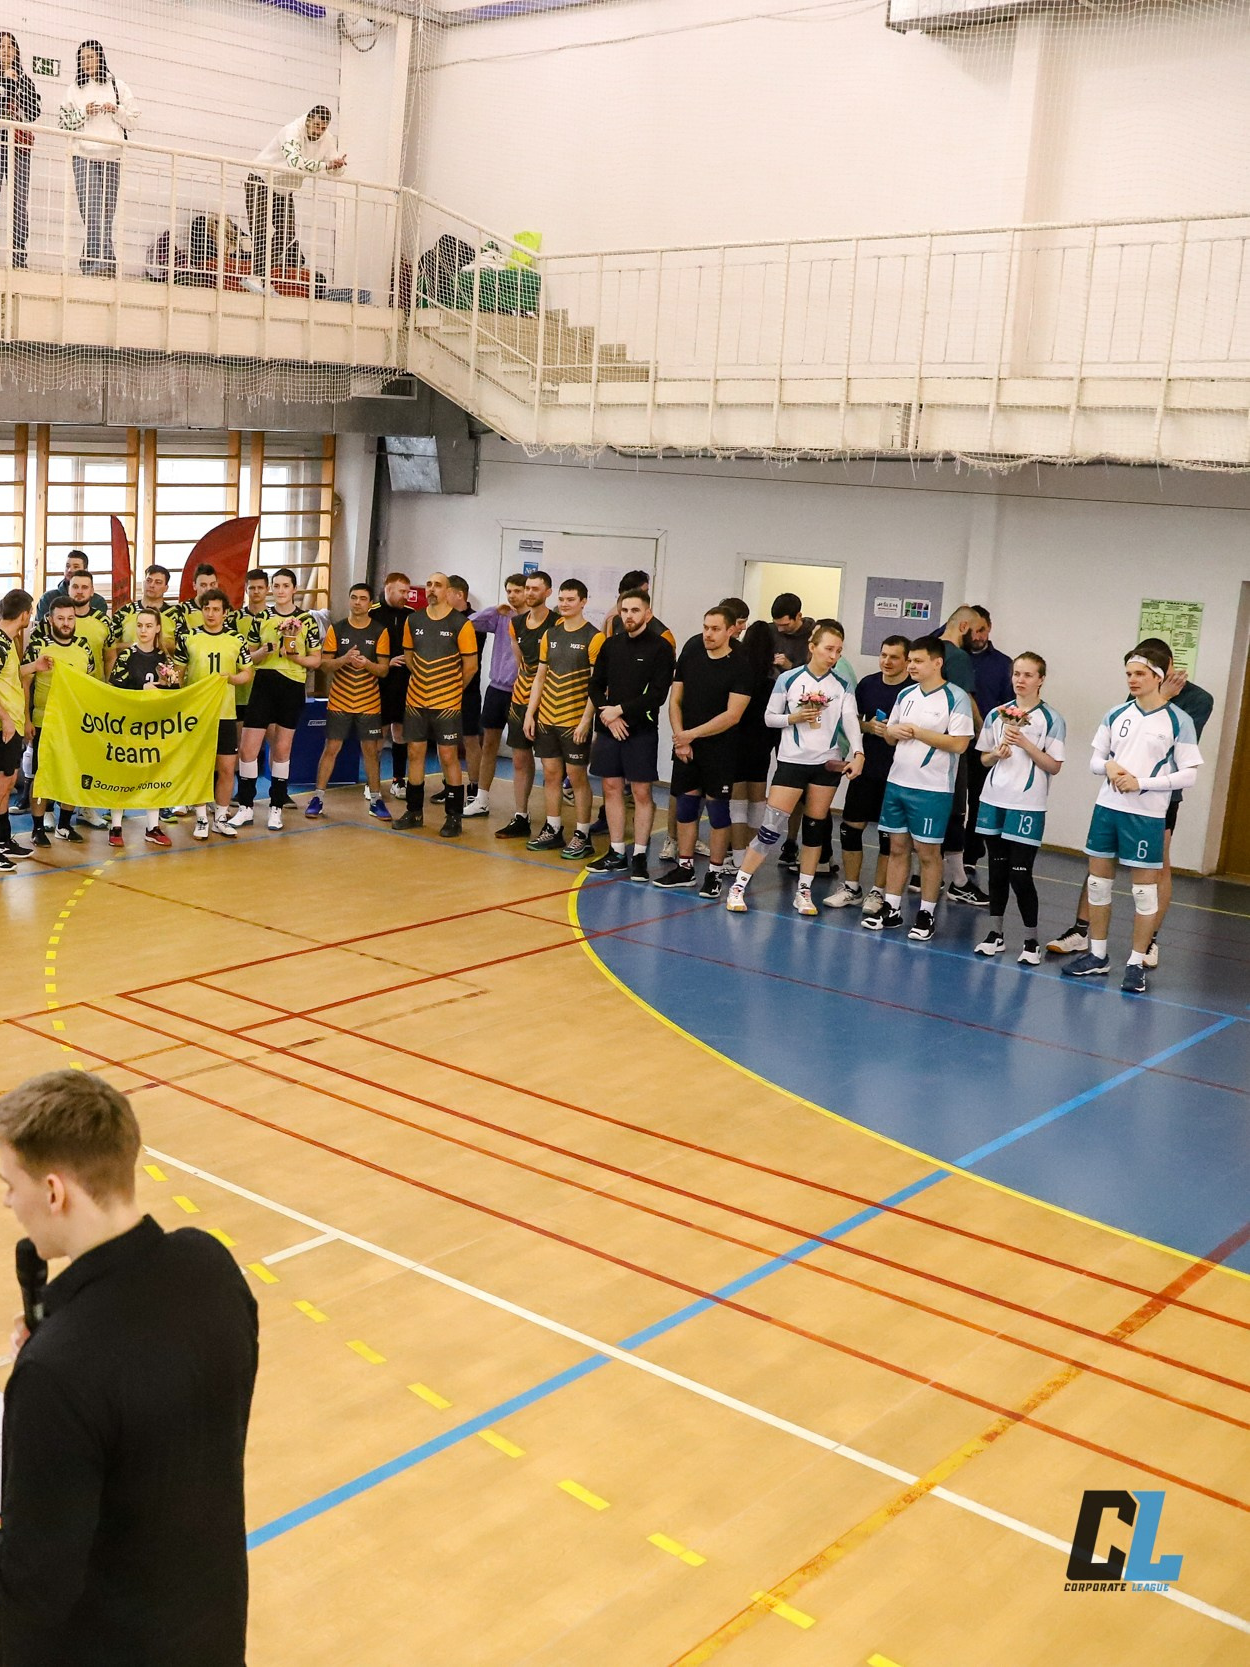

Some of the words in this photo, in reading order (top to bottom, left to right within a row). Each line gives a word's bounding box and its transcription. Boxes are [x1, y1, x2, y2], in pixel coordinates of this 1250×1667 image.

[208, 652, 220, 675] 11
[903, 700, 914, 717] 11
[81, 712, 126, 734] gold
[130, 711, 198, 740] apple
[1119, 718, 1131, 738] 6
[106, 742, 161, 763] team
[94, 780, 136, 793] Золотое
[923, 818, 932, 835] 11
[1018, 814, 1034, 835] 13
[1136, 840, 1148, 859] 6
